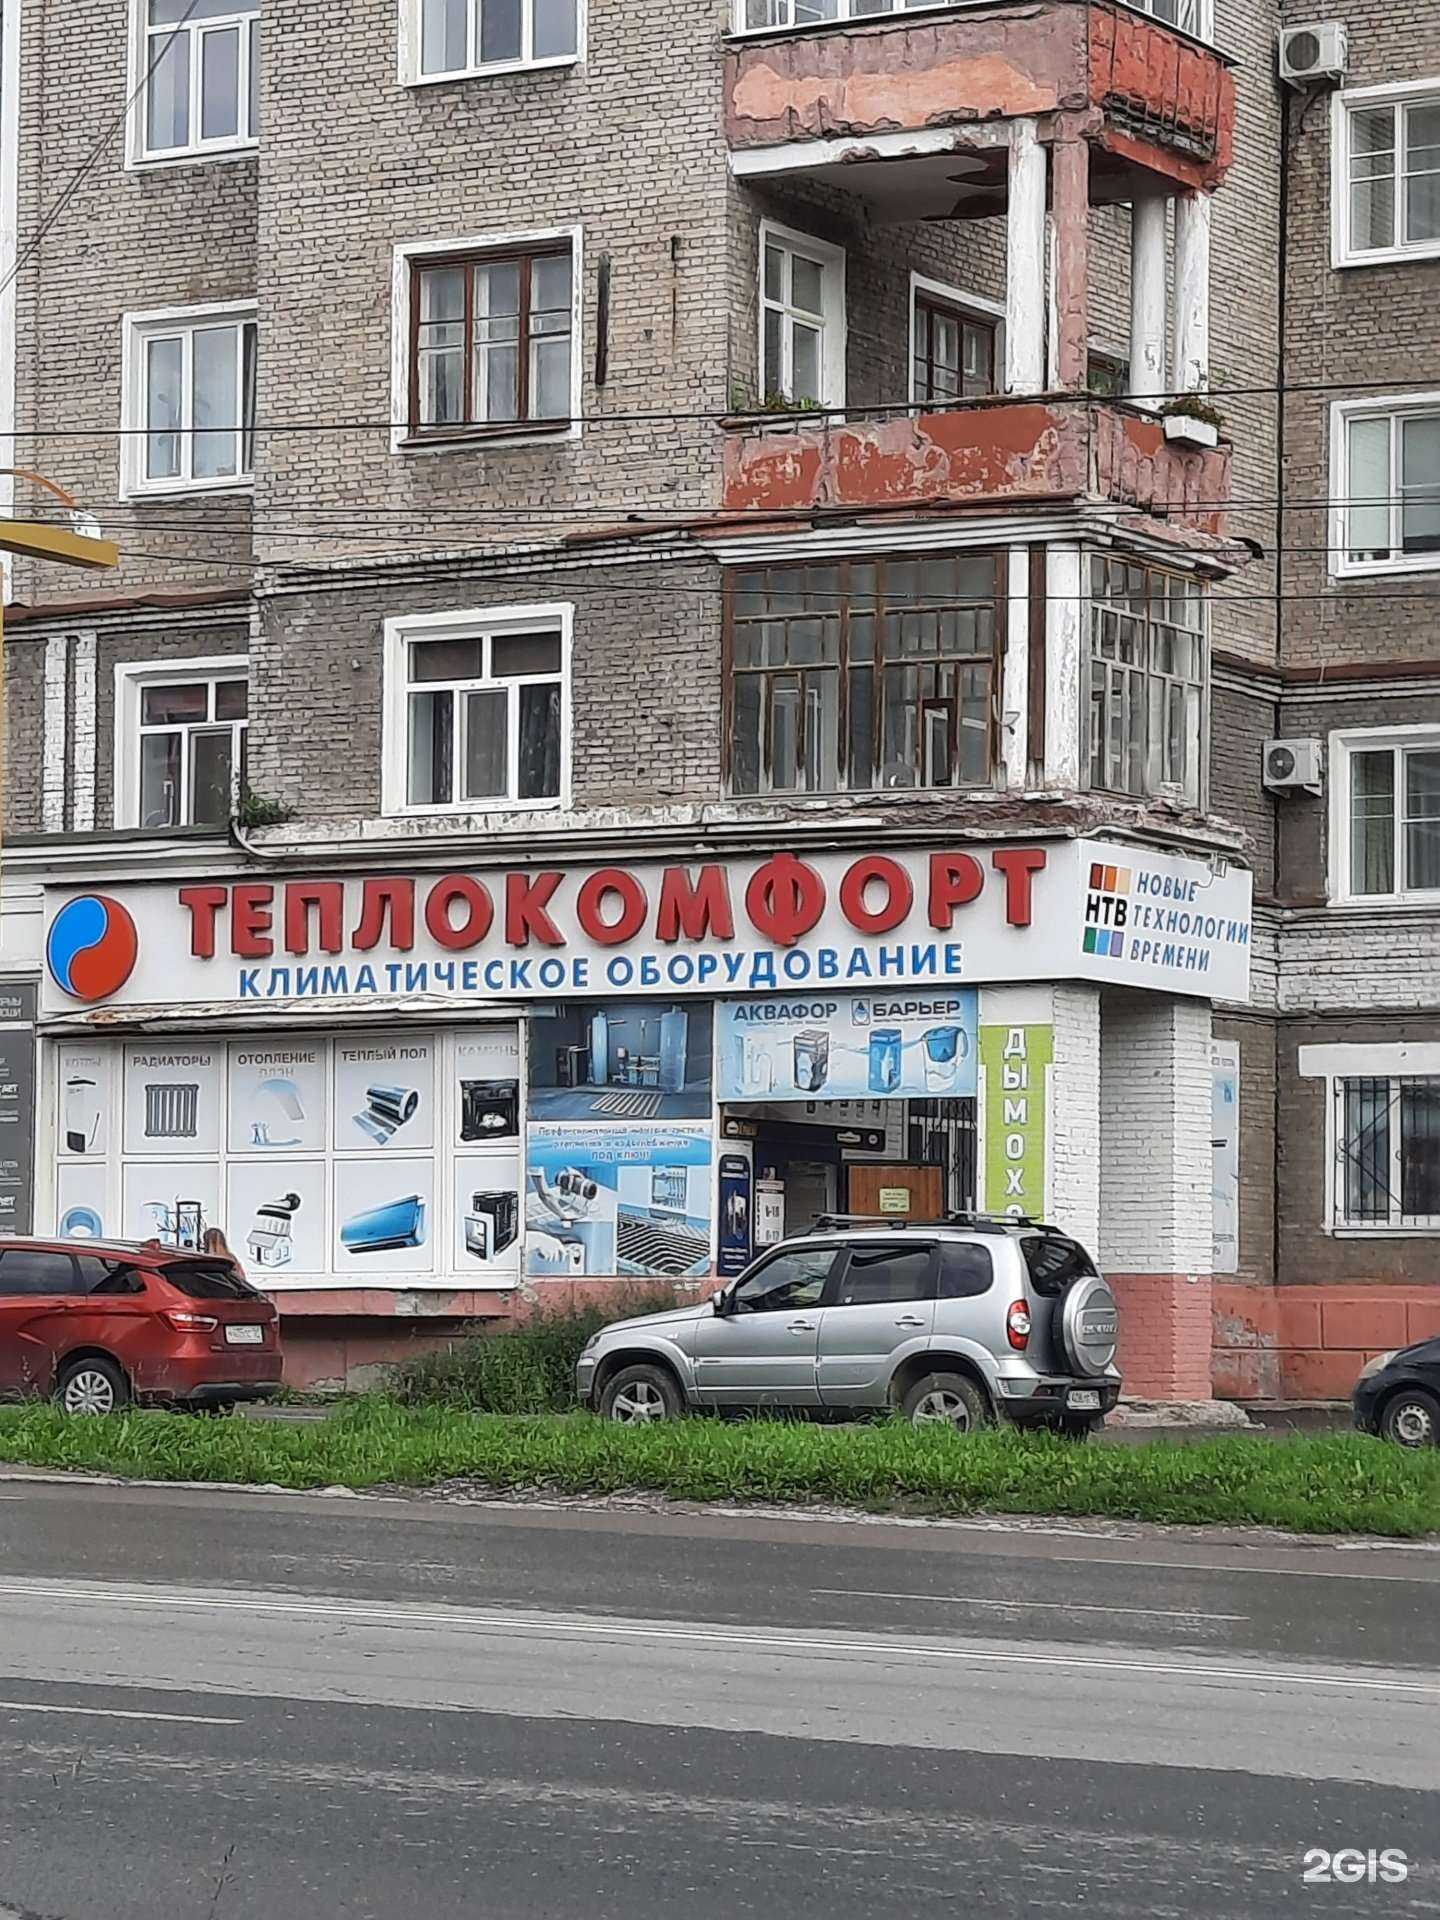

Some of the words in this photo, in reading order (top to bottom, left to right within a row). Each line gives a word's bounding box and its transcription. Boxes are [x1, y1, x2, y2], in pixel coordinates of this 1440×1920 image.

[1136, 871, 1199, 902] НОВЫЕ
[178, 848, 1047, 959] ТЕПЛОКОМФОРТ
[1084, 893, 1128, 927] НТВ
[1133, 904, 1249, 945] ТЕХНОЛОГИИ
[239, 957, 589, 998] КЛИМАТИЧЕСКОЕ
[606, 943, 963, 989] ОБОРУДОВАНИЕ
[1130, 938, 1210, 972] ВРЕМЕНИ
[732, 1002, 838, 1021] АКВАФОР
[872, 1000, 961, 1017] БАРЬЕР
[132, 1055, 212, 1068] РАДИАТОРЫ
[237, 1051, 316, 1066] ОТОПЛЕНИЕ
[400, 1047, 428, 1060] ПОЛ
